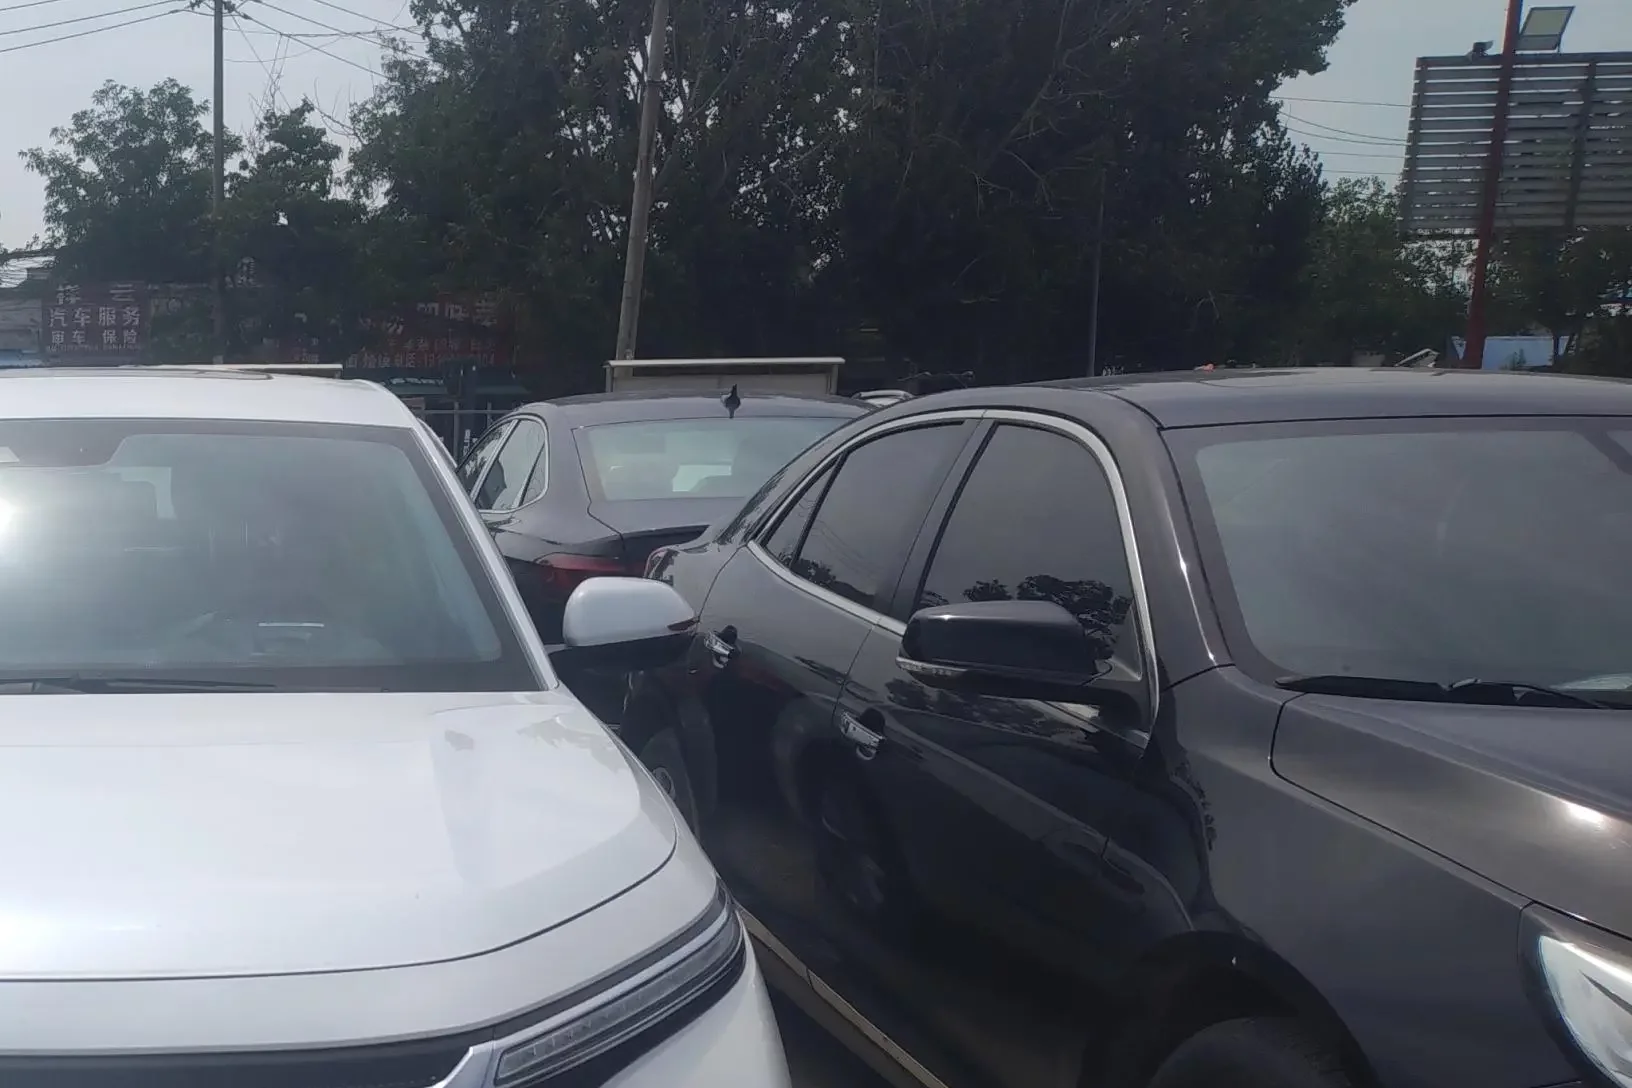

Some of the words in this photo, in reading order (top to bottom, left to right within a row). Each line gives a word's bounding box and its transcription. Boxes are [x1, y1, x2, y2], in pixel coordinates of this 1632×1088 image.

[49, 306, 141, 327] 汽车服务
[102, 329, 138, 346] 保险
